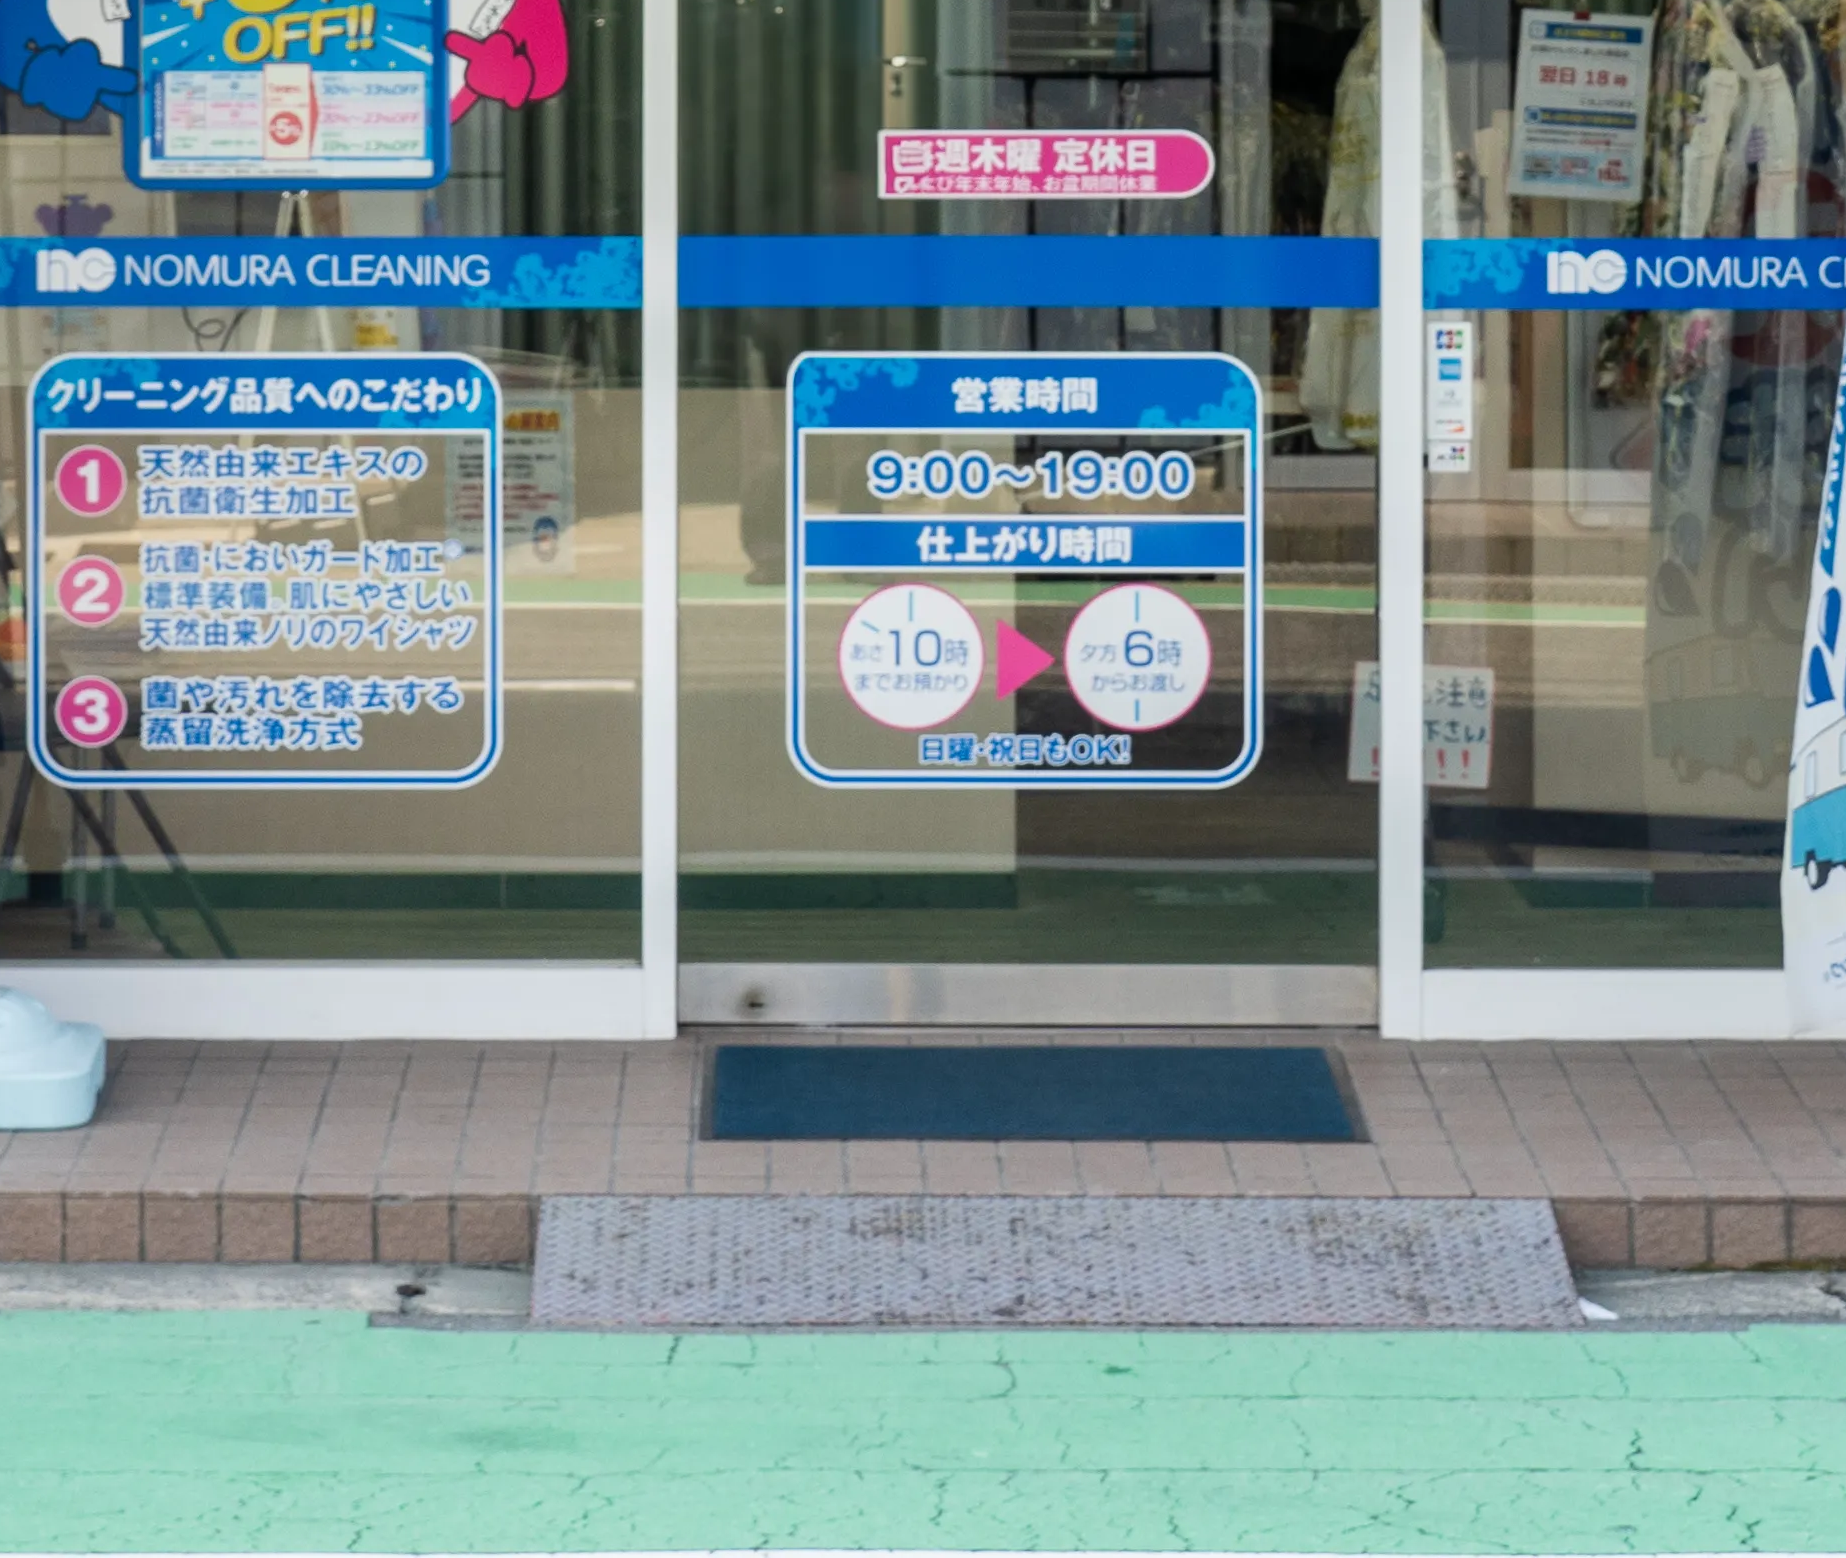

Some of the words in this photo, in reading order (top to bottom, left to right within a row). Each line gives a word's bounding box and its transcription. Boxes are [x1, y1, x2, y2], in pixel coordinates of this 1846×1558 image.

[223, 6, 375, 64] OFF!!
[1054, 139, 1156, 173] 定休日
[124, 254, 295, 286] NOMURA
[306, 253, 490, 287] CLEANING
[1636, 256, 1807, 289] NOMURA
[48, 377, 482, 414] クリーニング品質へのこだわり
[951, 377, 1098, 413] 営業時間
[138, 446, 427, 480] 天然由来エキスの
[138, 485, 358, 518] 抗菌衛生加工
[916, 525, 1133, 563] 仕上がり時間
[141, 617, 477, 650] 天然由来ノリのワイシャツ
[143, 677, 464, 712] 菌や汚れを除去する
[854, 670, 970, 694] までお預かり
[1091, 672, 1186, 695] からお渡し
[142, 713, 363, 750] 蒸留洗浄方式
